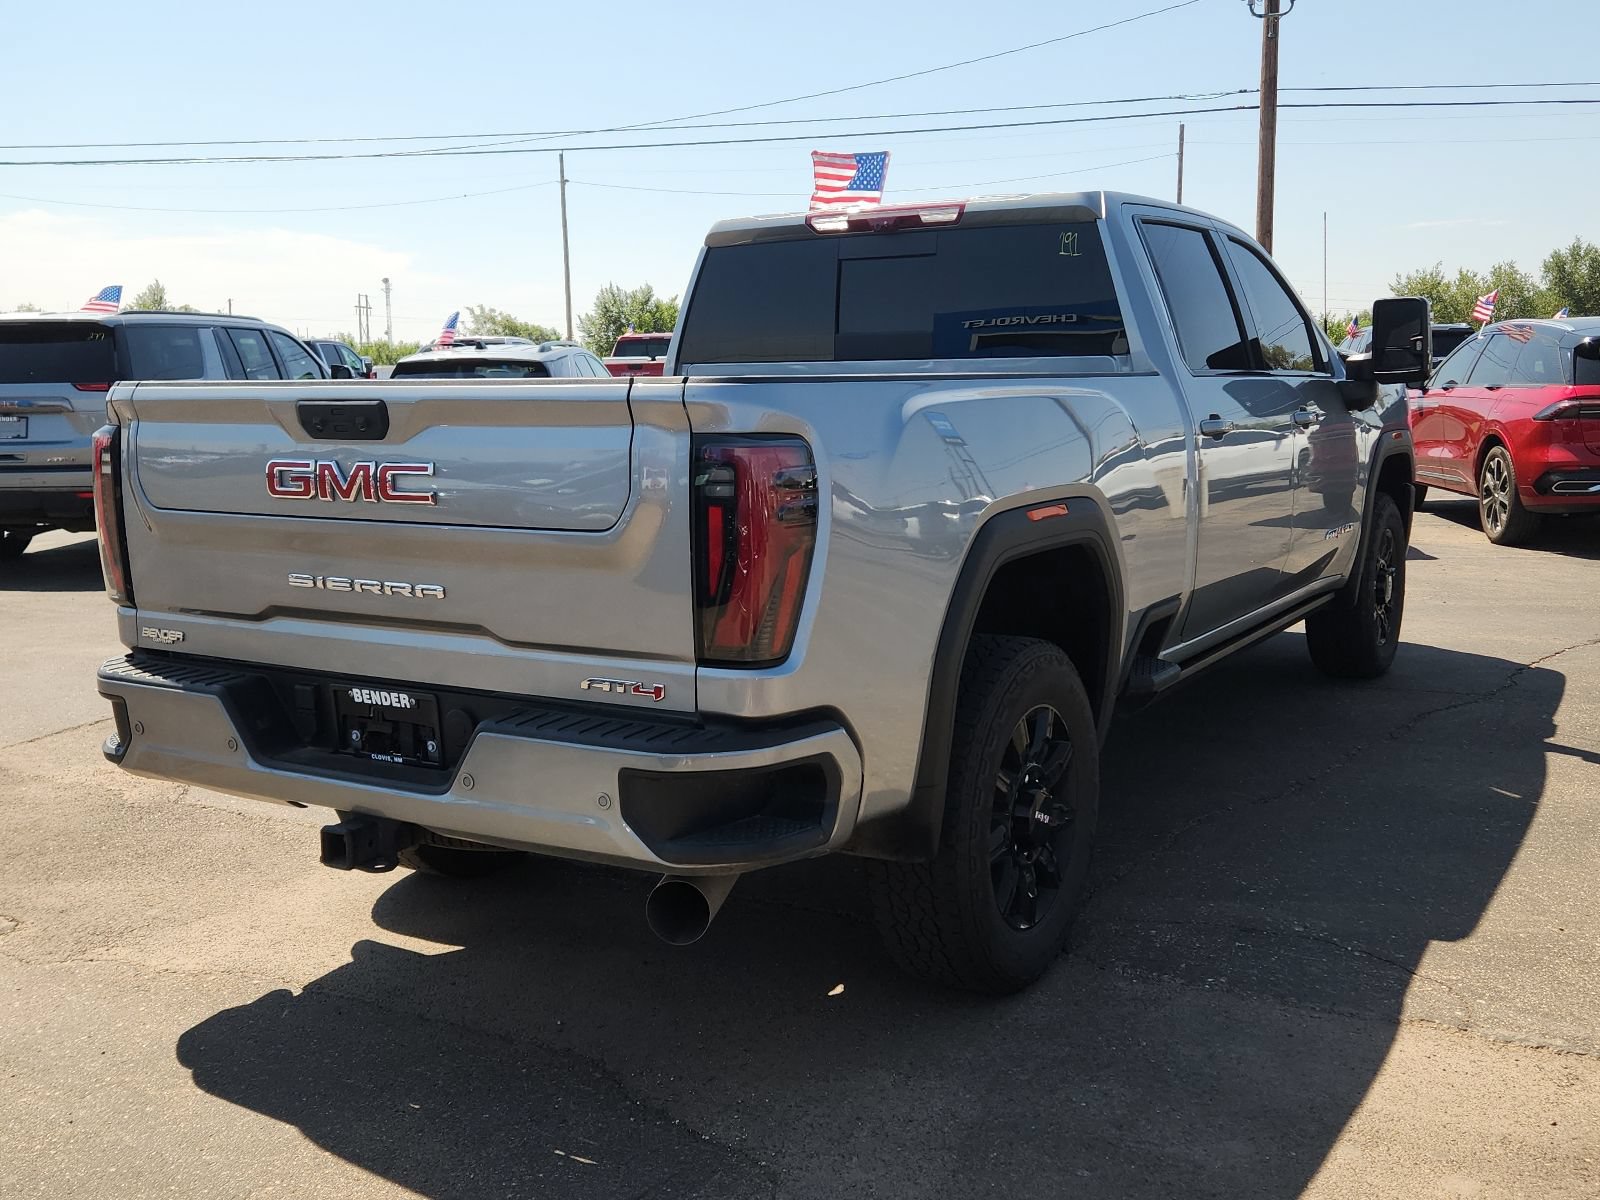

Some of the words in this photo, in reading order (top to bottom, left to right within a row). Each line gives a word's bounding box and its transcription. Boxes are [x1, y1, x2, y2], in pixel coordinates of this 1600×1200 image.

[1059, 231, 1082, 256] 191
[266, 459, 437, 505] GMC
[288, 573, 446, 599] SIERRA
[142, 626, 184, 642] BENDER
[352, 688, 411, 708] BENDER
[580, 677, 665, 702] AT4
